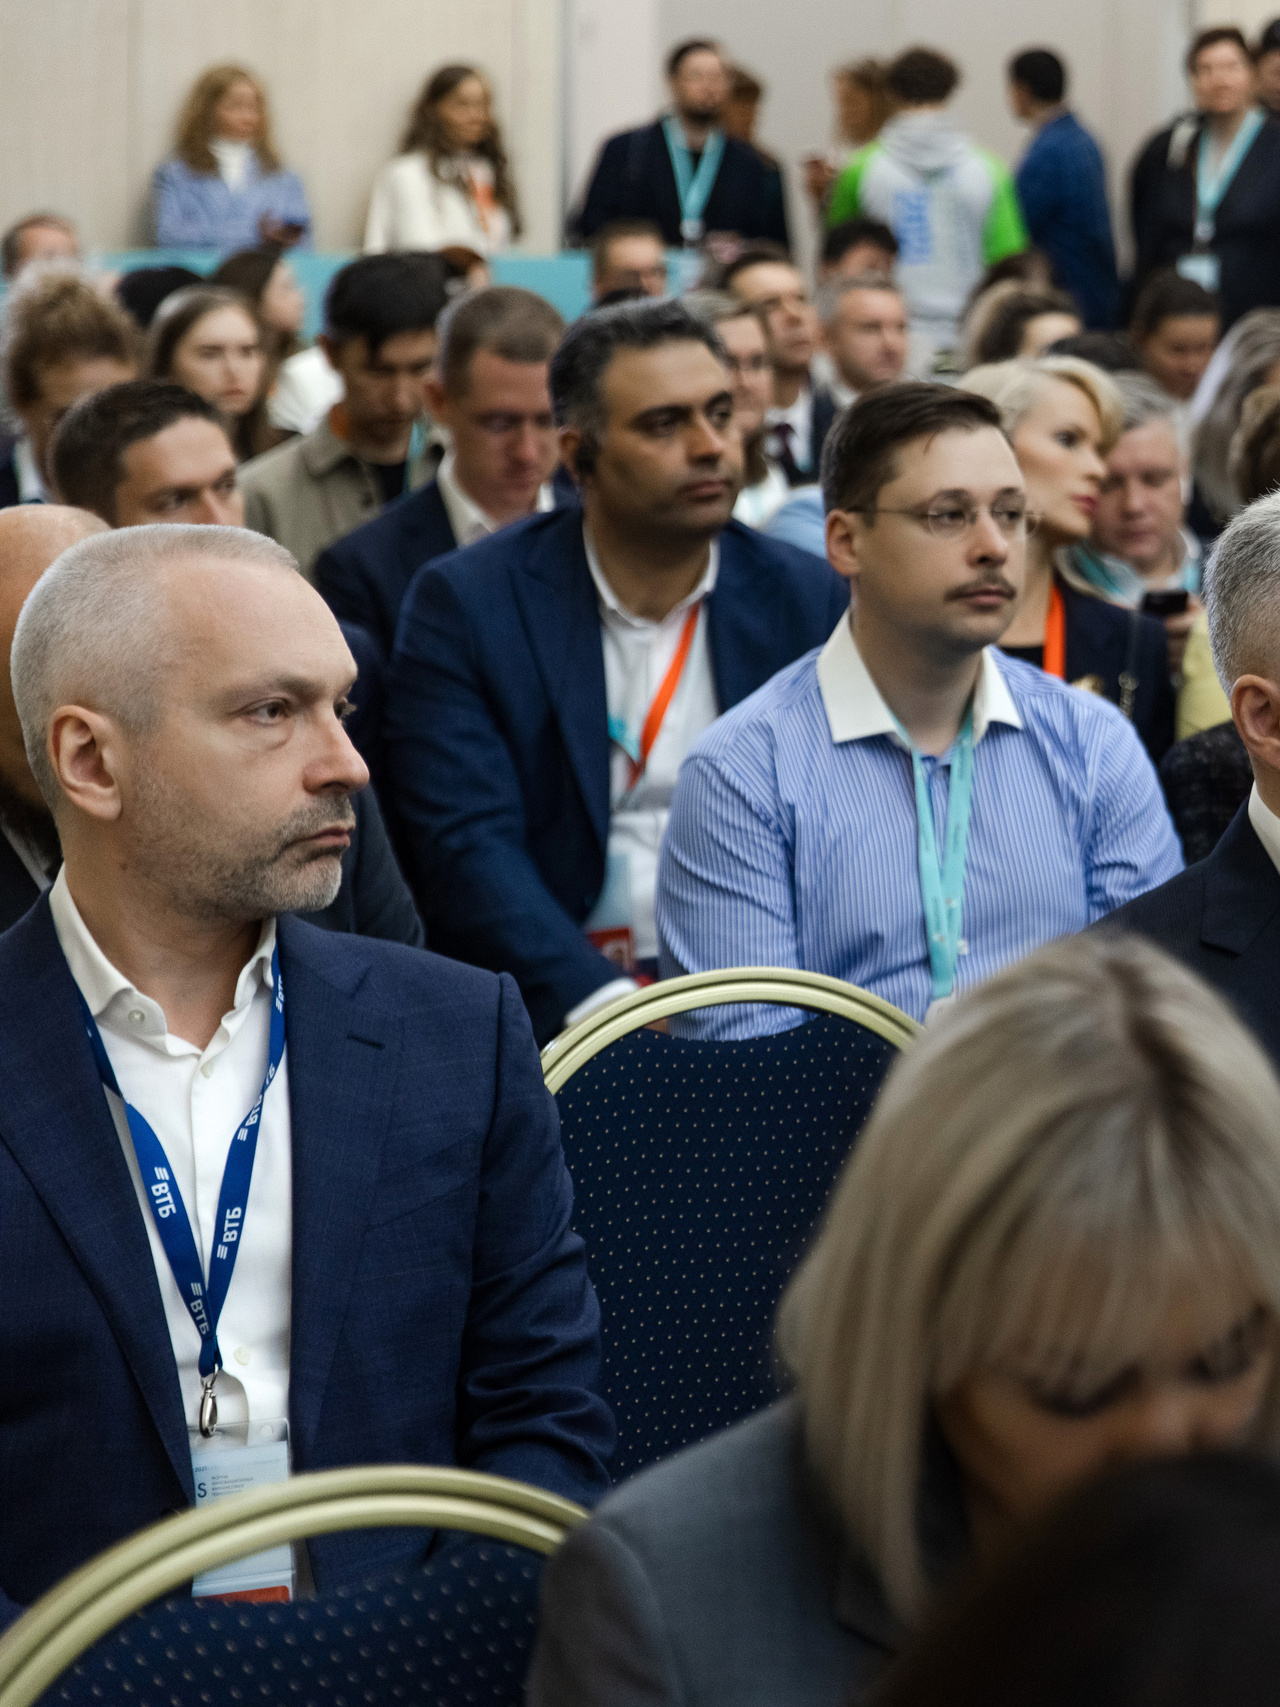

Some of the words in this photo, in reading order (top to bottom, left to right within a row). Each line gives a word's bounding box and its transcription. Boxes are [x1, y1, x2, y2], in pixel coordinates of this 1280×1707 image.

[151, 1181, 177, 1219] ВТБ
[222, 1206, 242, 1243] ВТБ
[190, 1298, 210, 1336] ВТБ
